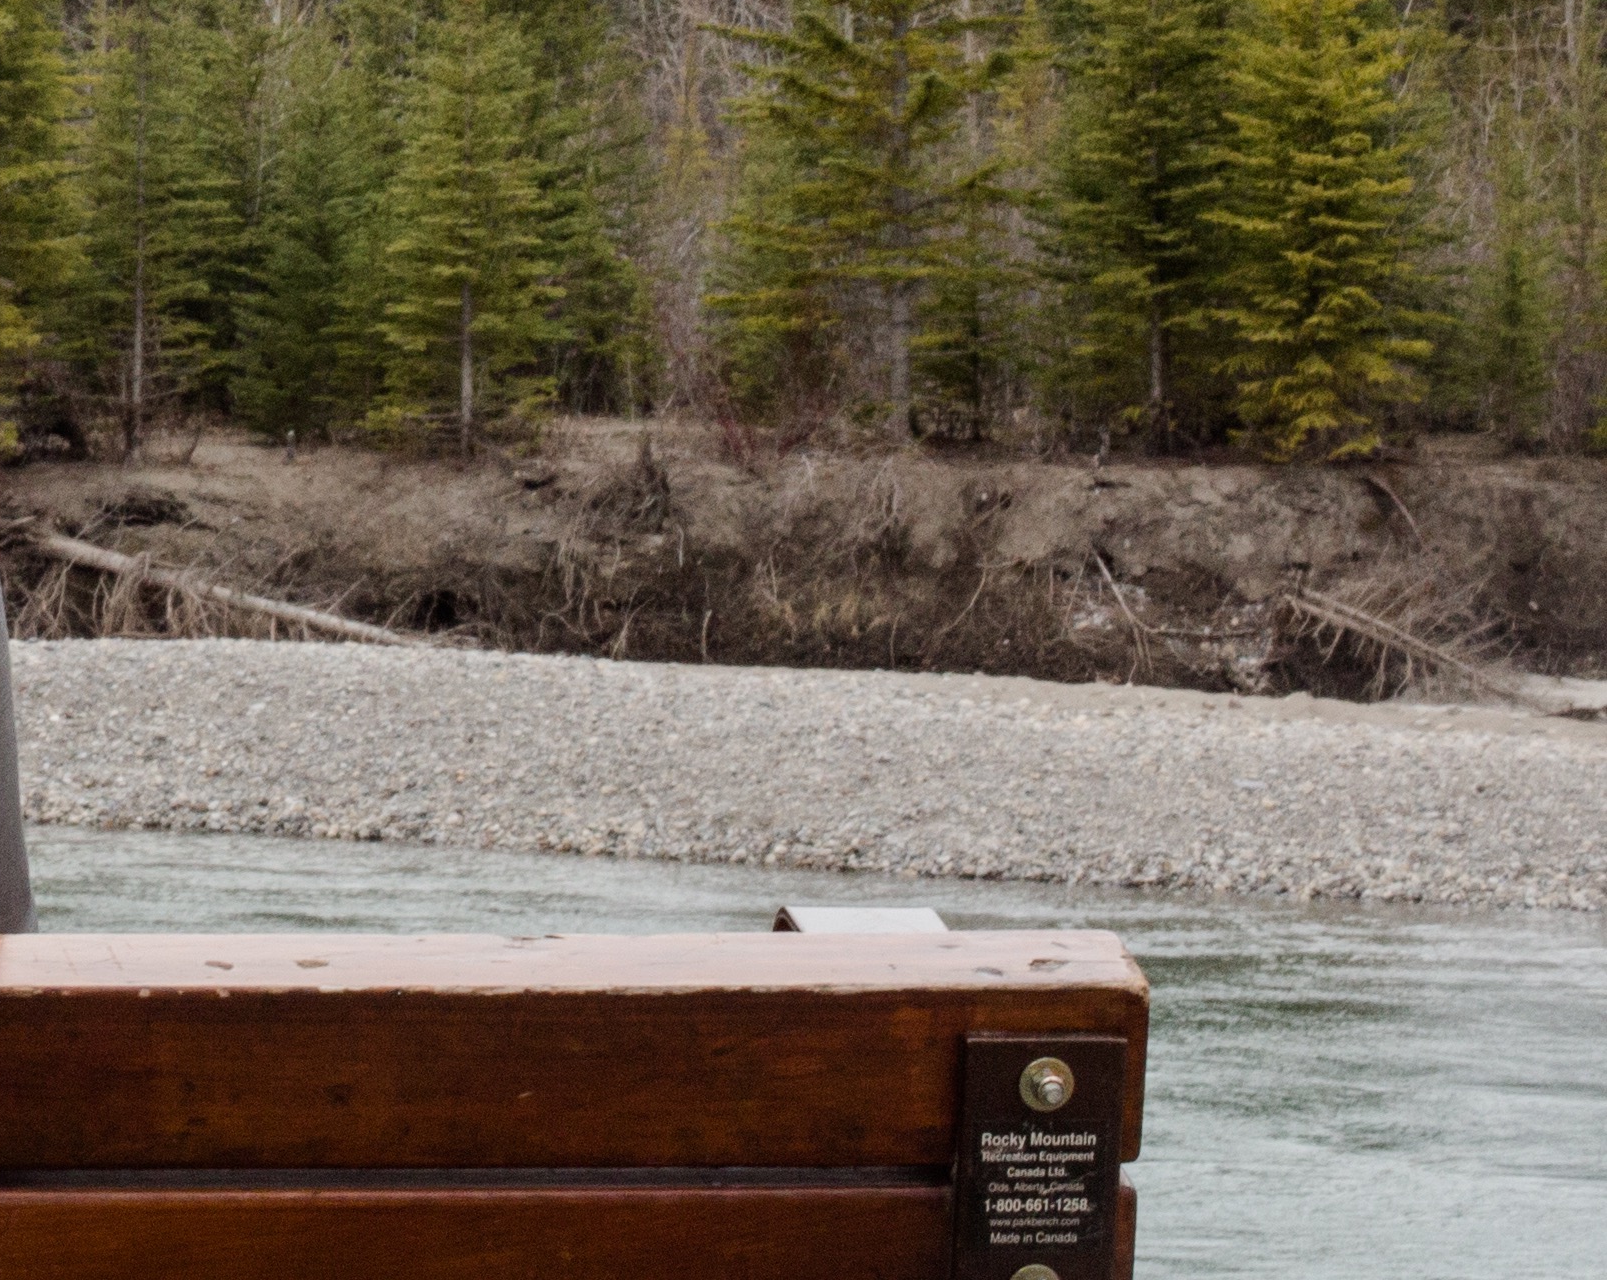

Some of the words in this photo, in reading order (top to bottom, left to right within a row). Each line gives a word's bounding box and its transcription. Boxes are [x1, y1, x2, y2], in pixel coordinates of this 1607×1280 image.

[981, 1132, 1027, 1149] Rocky
[1030, 1132, 1097, 1146] Mountain
[1039, 1151, 1095, 1163] Equipment
[1007, 1167, 1046, 1177] Canada
[990, 1232, 1020, 1244] Made
[1023, 1232, 1033, 1243] in
[1035, 1231, 1078, 1243] Canada
